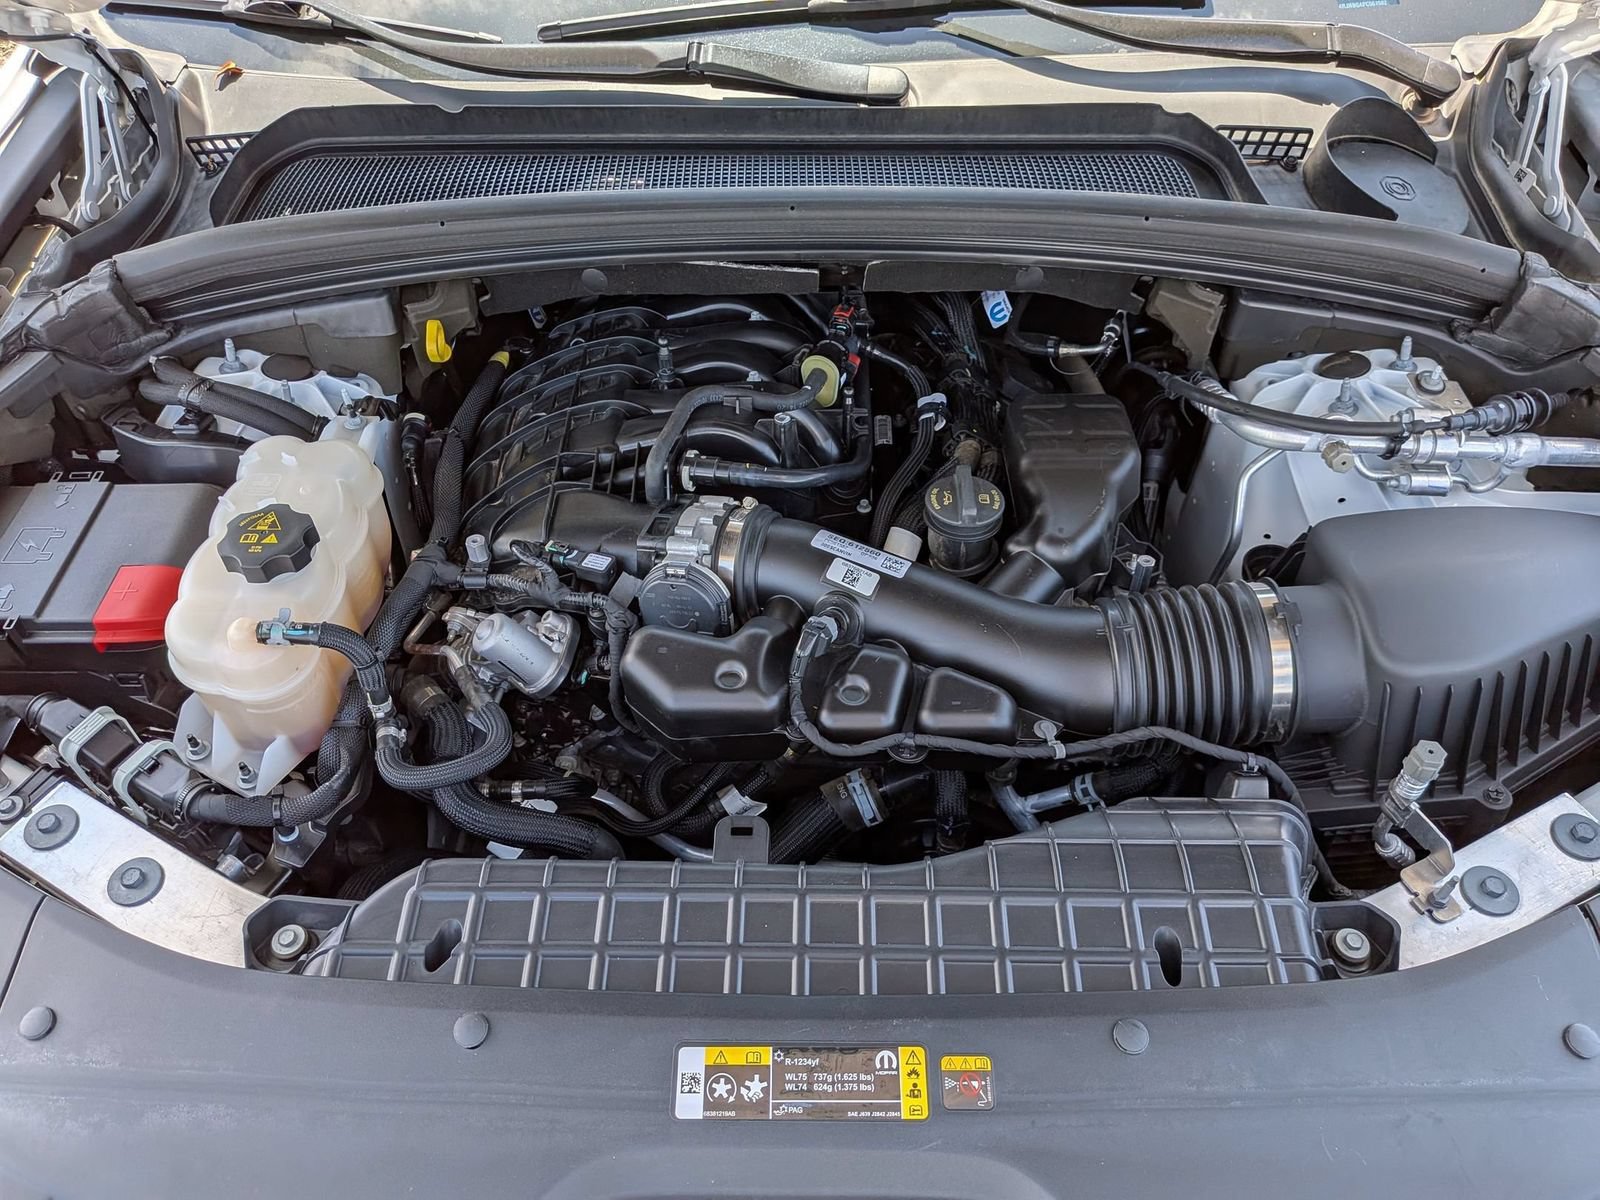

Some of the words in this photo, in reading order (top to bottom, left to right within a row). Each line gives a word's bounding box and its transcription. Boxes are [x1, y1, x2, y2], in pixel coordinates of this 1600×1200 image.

[784, 1057, 820, 1066] R-1234yf
[784, 1073, 808, 1081] WL75
[813, 1073, 833, 1082] 737g
[834, 1073, 859, 1082] (1.625
[859, 1073, 875, 1082] lbs)
[784, 1083, 808, 1091] WL74
[813, 1083, 833, 1092] 624g
[834, 1083, 859, 1092] (1.375
[859, 1083, 875, 1092] lbs)
[788, 1106, 804, 1114] PAG
